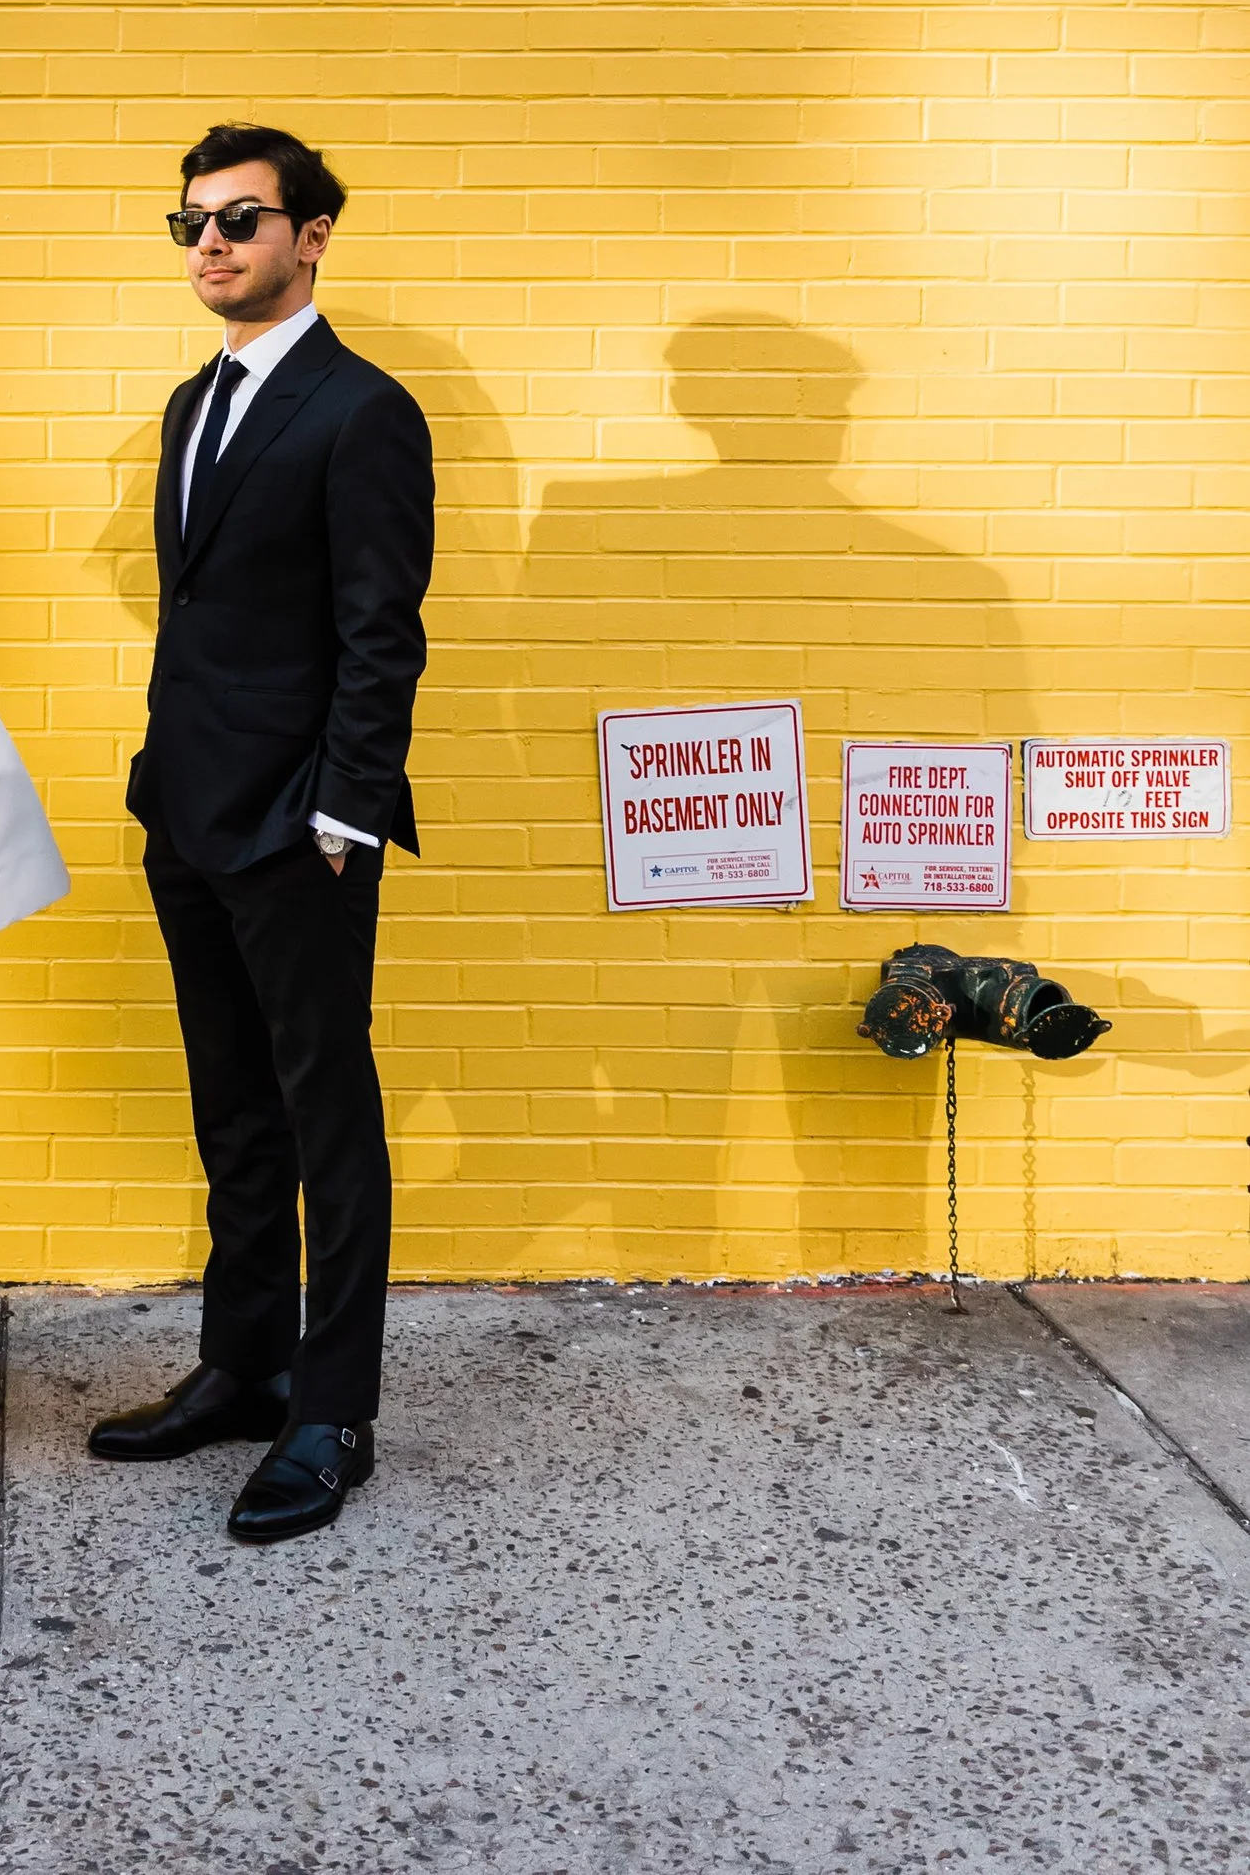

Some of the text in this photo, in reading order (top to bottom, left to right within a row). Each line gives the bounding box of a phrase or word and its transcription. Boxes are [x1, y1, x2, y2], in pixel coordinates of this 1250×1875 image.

[629, 737, 771, 779] SPRINKLER IN
[1036, 749, 1218, 768] AUTOMATIC SPRINKLER
[889, 766, 970, 789] FIRE DEPT.
[1064, 770, 1190, 788] SHUT OFF VALVE
[859, 793, 995, 818] CONNECTION FOR
[1145, 791, 1182, 808] FEET
[624, 791, 784, 834] BASEMENT ONLY
[1047, 811, 1209, 829] OPPOSITE THIS SIGN
[862, 822, 995, 846] AUTO SPRINKLER
[664, 866, 700, 874] CAPITOL
[710, 869, 770, 880] 718-533-6800
[716, 863, 755, 871] INSTALLATION
[878, 872, 912, 881] CAPITOL
[924, 882, 994, 893] 718-533-6800
